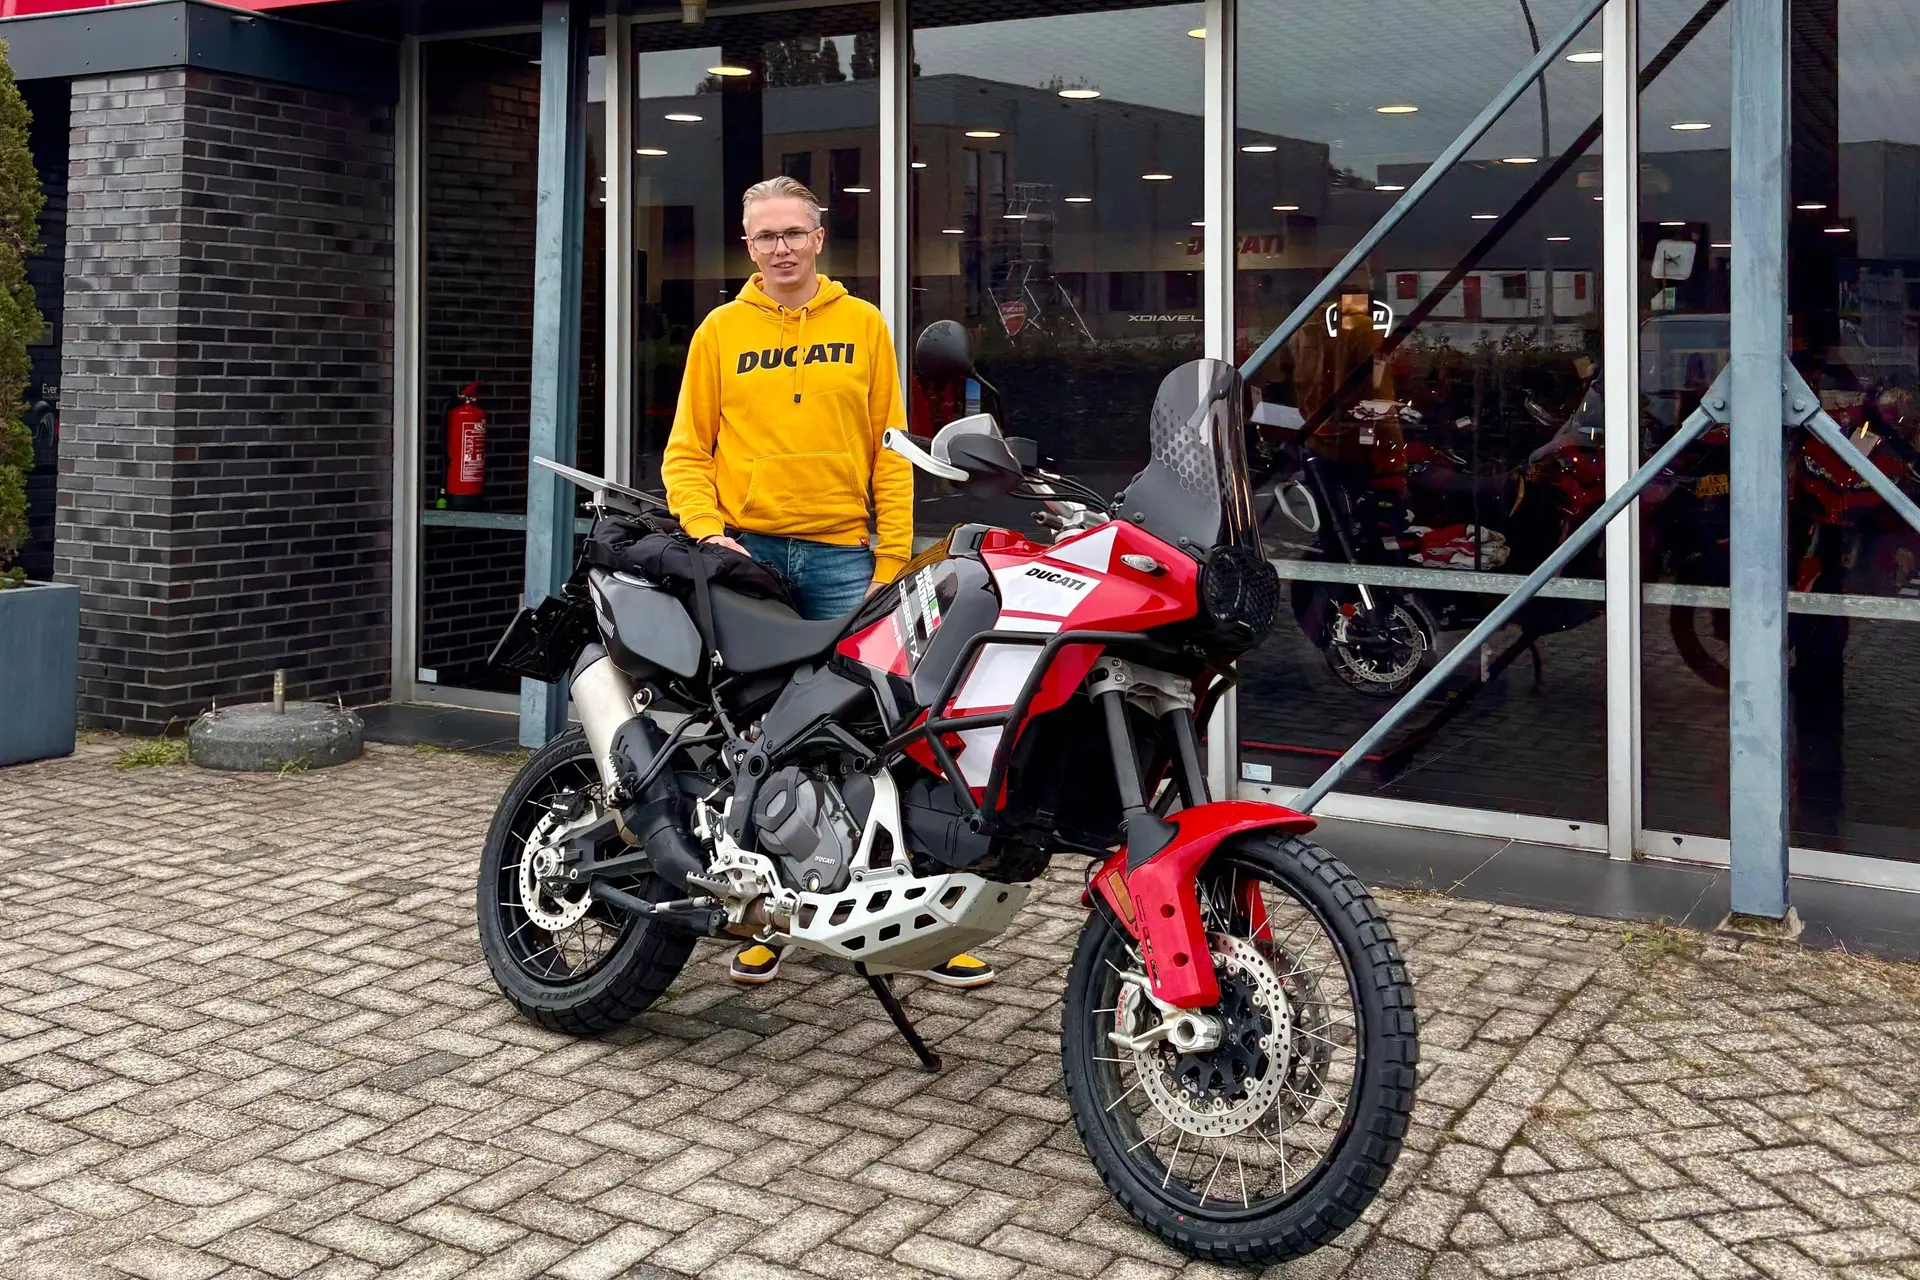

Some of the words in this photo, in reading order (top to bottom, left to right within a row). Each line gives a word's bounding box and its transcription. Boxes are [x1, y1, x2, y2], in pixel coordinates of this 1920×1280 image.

[1127, 314, 1204, 322] XDIAVEL
[736, 342, 855, 375] DUCATI
[922, 564, 937, 602] DUCATI
[1024, 567, 1087, 591] DUCATI
[814, 855, 836, 865] DUCATI
[1116, 989, 1128, 1028] brembo
